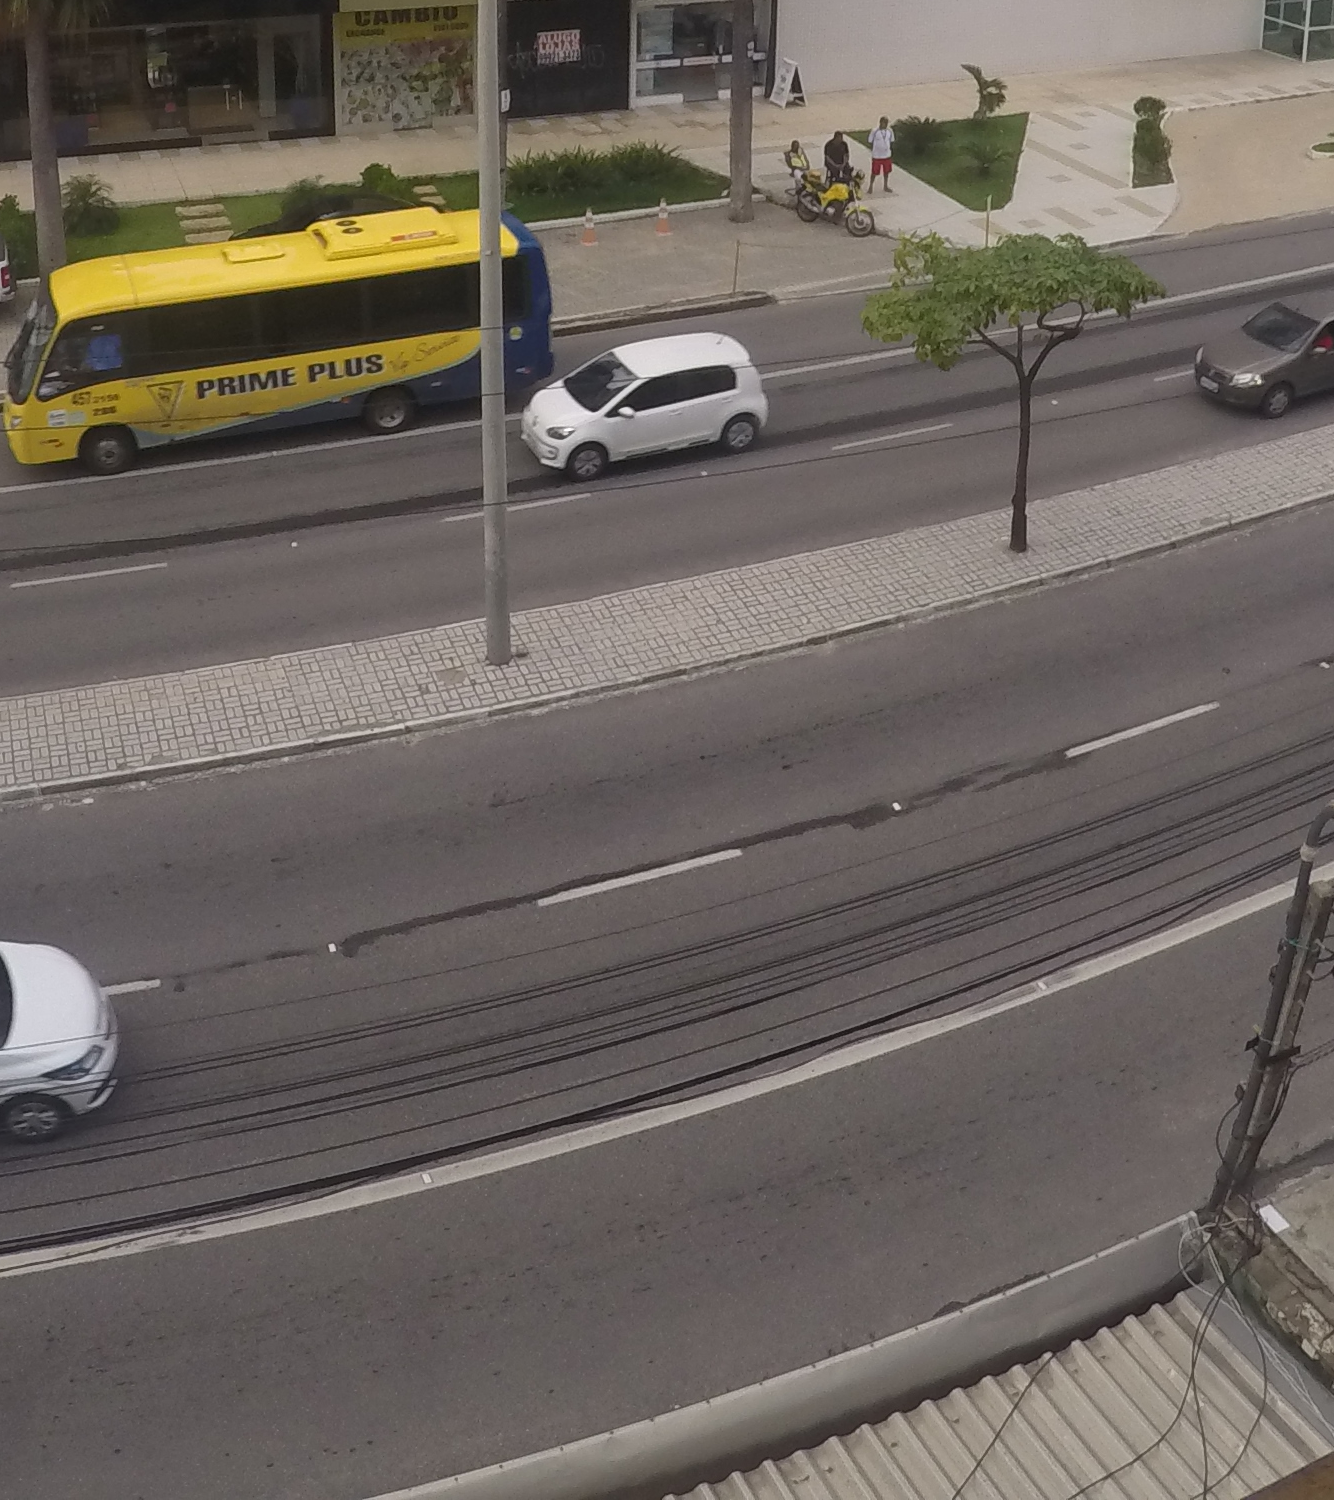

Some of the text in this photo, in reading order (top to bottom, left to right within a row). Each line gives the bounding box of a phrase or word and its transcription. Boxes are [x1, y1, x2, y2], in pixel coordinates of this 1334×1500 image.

[538, 31, 580, 44] ALUGO
[539, 40, 580, 54] LOJAS
[195, 366, 297, 399] PRIME
[307, 354, 385, 383] PLUS
